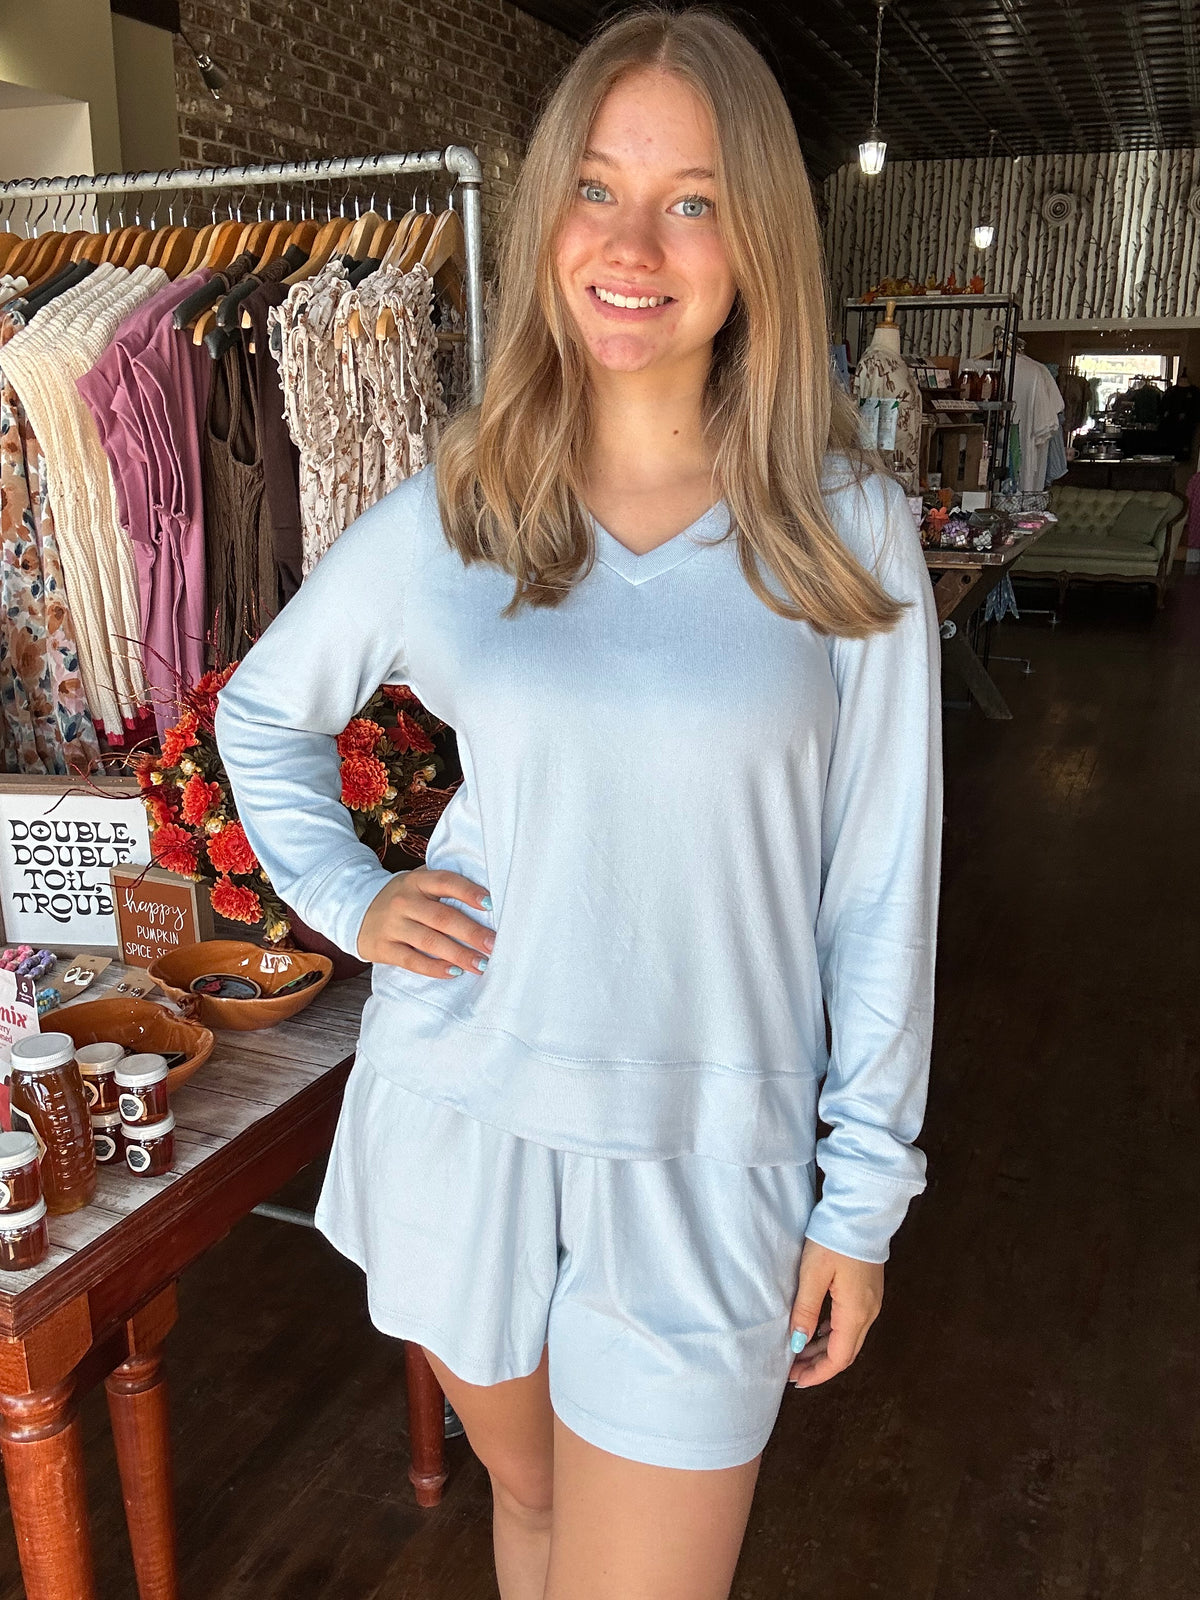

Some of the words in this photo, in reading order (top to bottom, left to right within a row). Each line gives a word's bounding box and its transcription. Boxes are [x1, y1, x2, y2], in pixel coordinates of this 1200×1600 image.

[8, 819, 137, 847] DOUBLE,
[123, 888, 187, 932] happy
[136, 925, 179, 945] PUMPKIN
[125, 942, 153, 959] SPICE
[21, 982, 28, 993] 6
